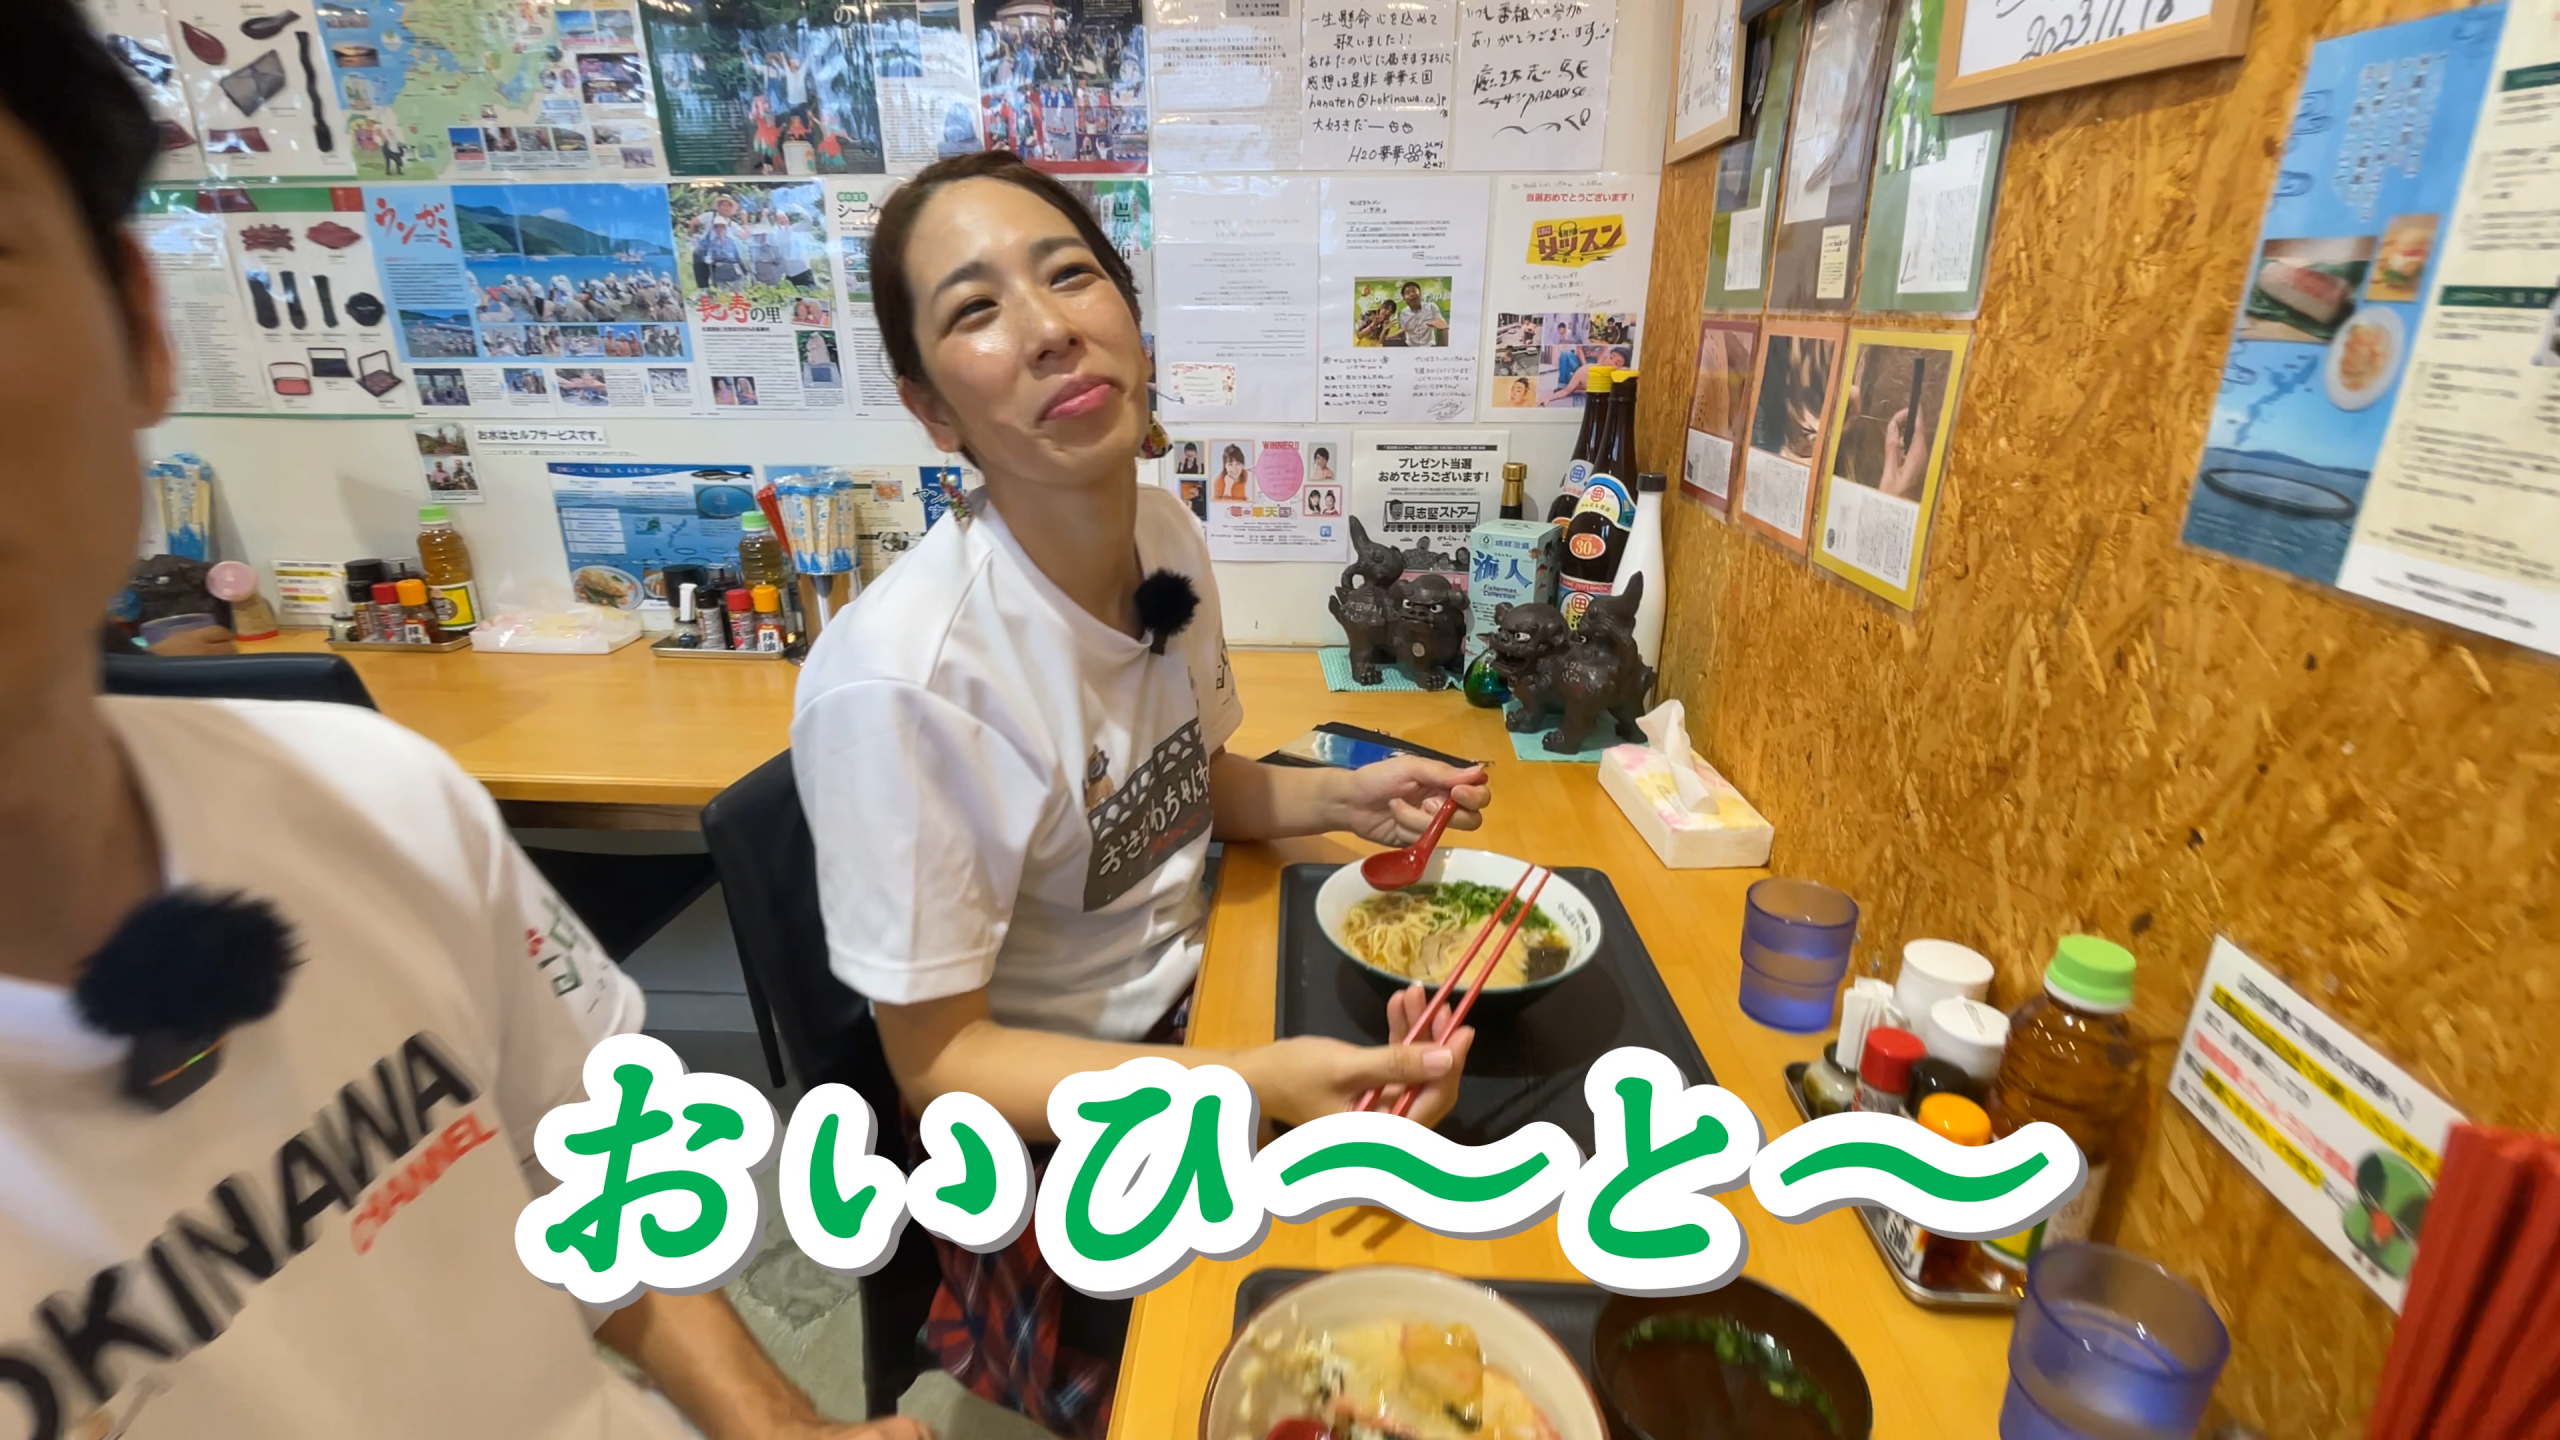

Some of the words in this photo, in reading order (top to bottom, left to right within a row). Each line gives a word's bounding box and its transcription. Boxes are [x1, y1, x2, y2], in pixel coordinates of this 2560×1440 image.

[375, 197, 453, 249] ウンガミ
[696, 291, 782, 323] 長寿の里
[477, 430, 604, 442] お水はセルフサービスです。
[1399, 458, 1472, 469] プレゼント当選
[1378, 472, 1489, 483] おめでとうございます!
[1404, 506, 1477, 520] 具志堅ストアー
[1472, 550, 1533, 588] 海人
